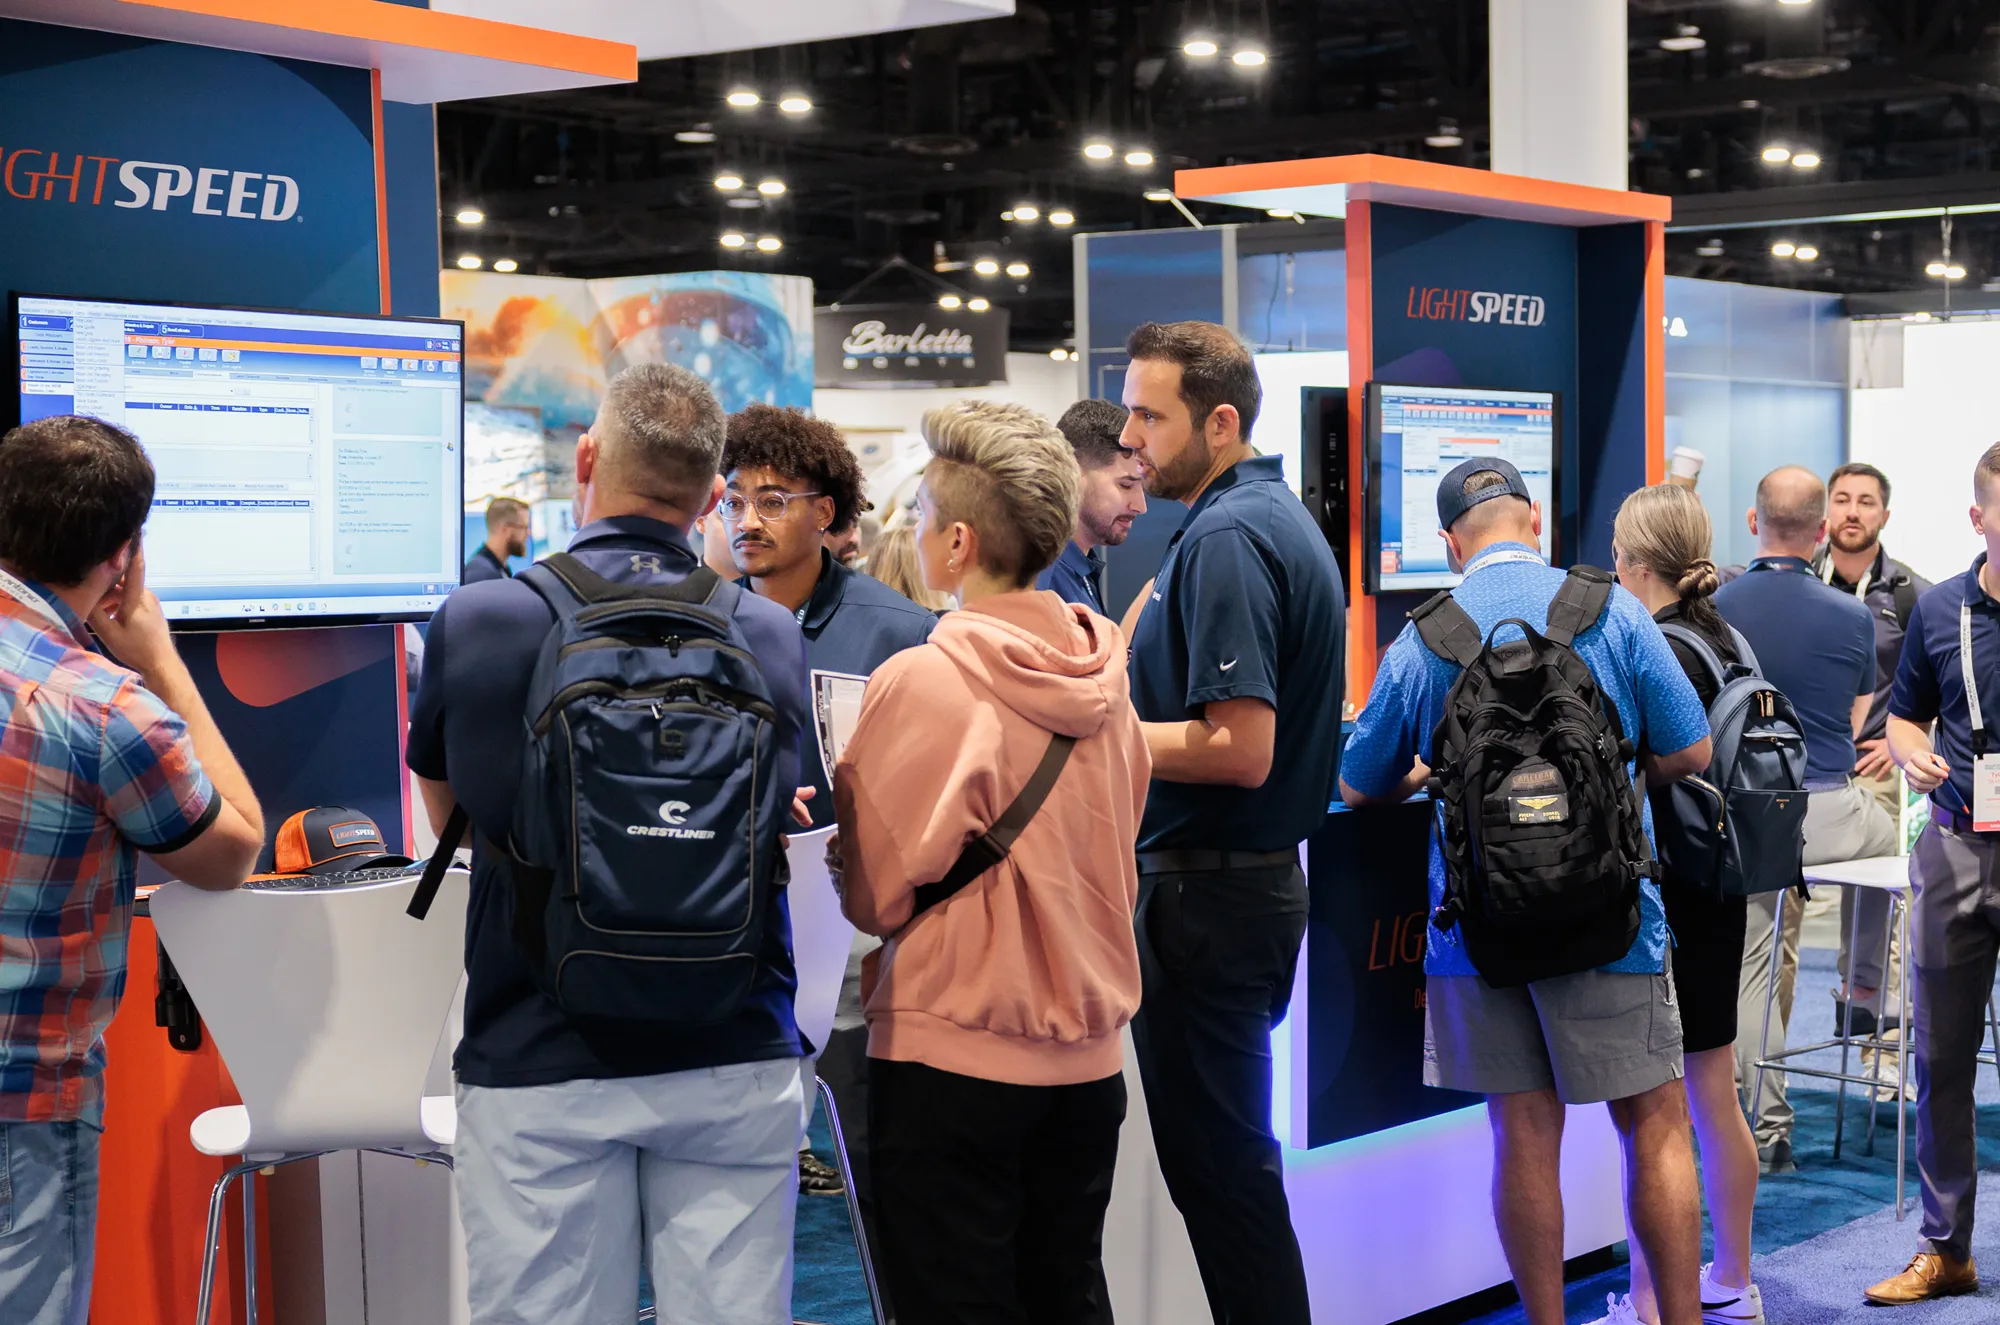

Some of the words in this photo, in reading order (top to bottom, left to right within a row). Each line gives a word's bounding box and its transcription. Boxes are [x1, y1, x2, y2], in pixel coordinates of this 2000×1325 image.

[0, 147, 300, 222] GHTSPEED
[1407, 286, 1546, 327] LIGHTSPEED
[842, 320, 973, 354] Barletta
[626, 825, 716, 839] CRESTLINER
[1368, 912, 1427, 971] LIG
